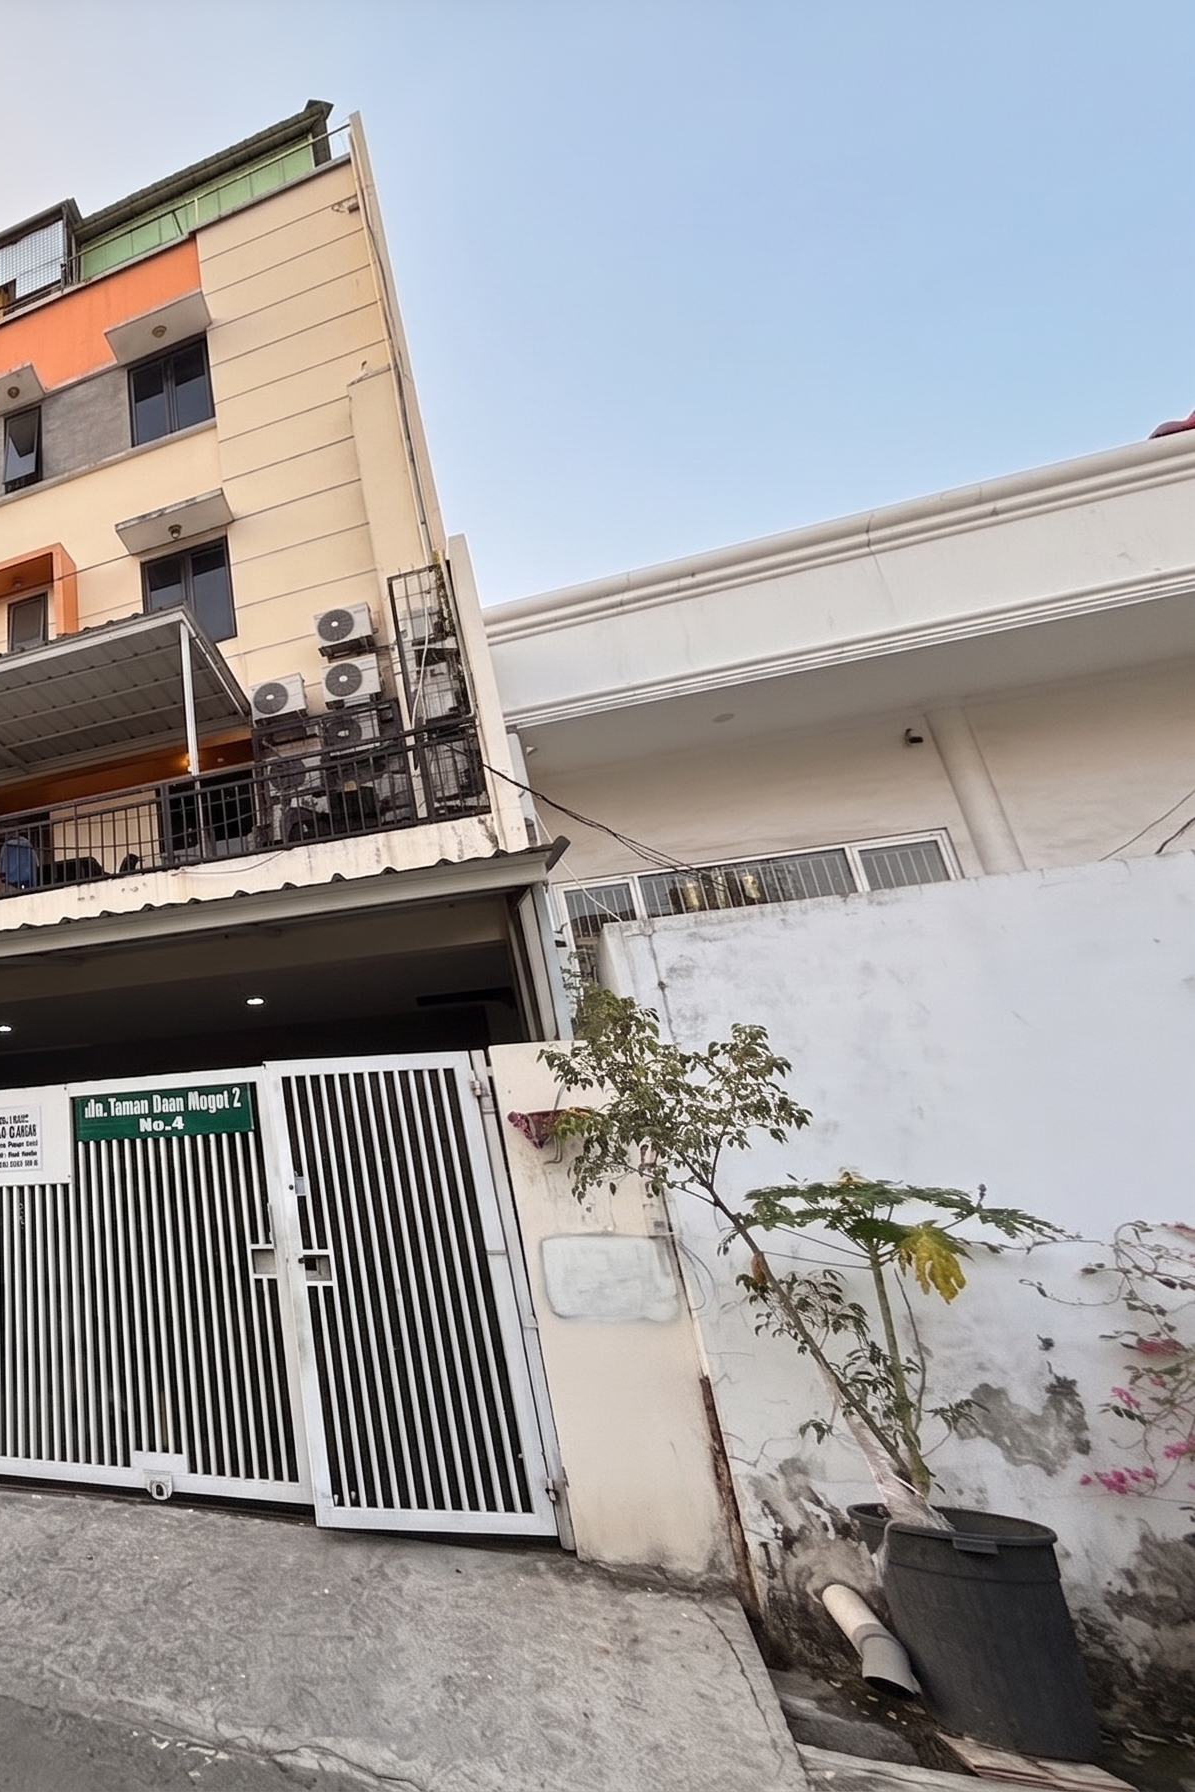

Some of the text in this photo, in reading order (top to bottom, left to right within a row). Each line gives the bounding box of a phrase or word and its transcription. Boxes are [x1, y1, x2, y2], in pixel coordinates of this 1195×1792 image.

[108, 1098, 149, 1117] Taman
[152, 1094, 185, 1114] Daan
[188, 1089, 230, 1114] Mogot
[232, 1087, 242, 1108] 2
